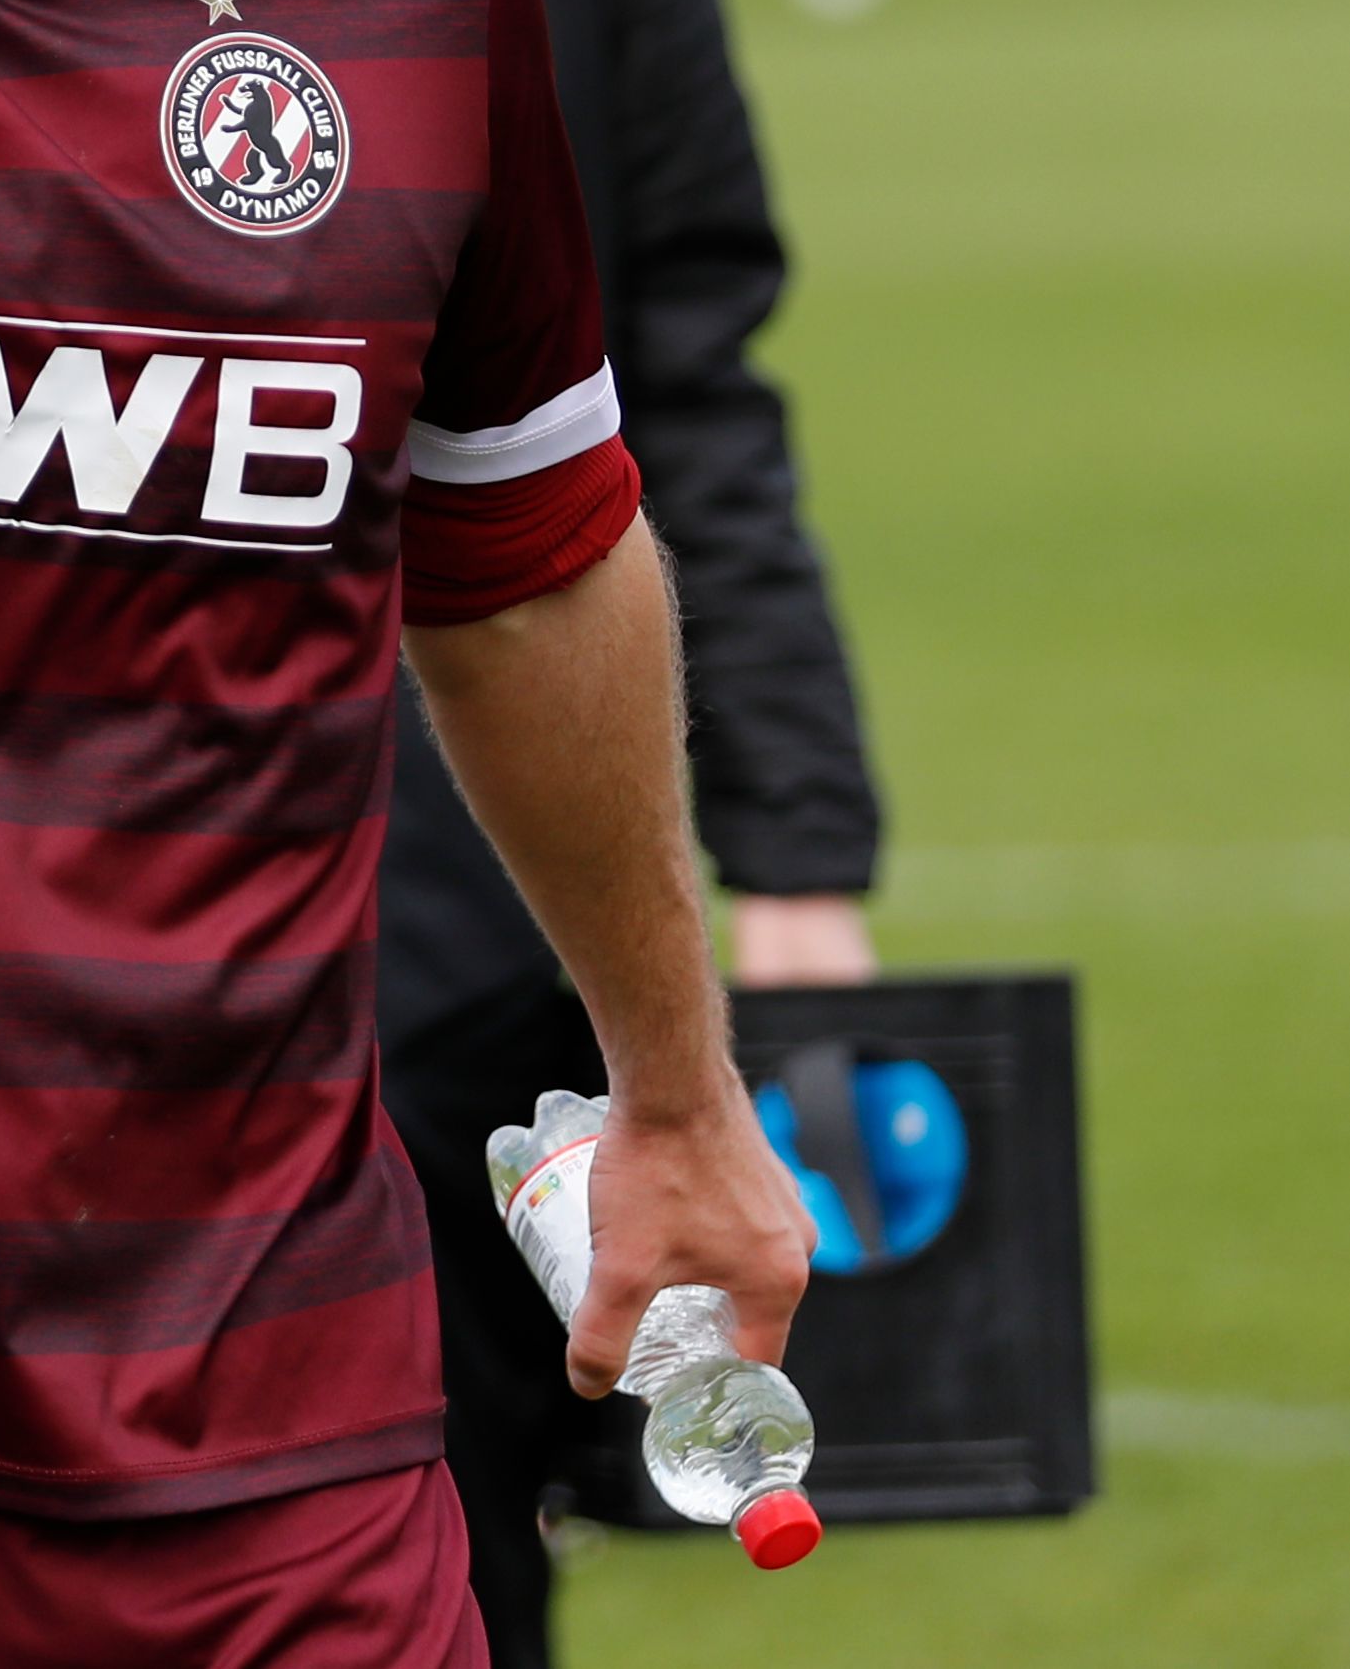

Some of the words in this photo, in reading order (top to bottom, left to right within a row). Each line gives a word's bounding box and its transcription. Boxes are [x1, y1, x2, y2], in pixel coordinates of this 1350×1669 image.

[177, 65, 215, 158] BERLINER
[210, 49, 300, 90] FUSSBALL
[301, 87, 334, 138] CLUB
[191, 167, 214, 187] 19
[313, 150, 336, 170] 66
[219, 179, 320, 219] DYNAMO
